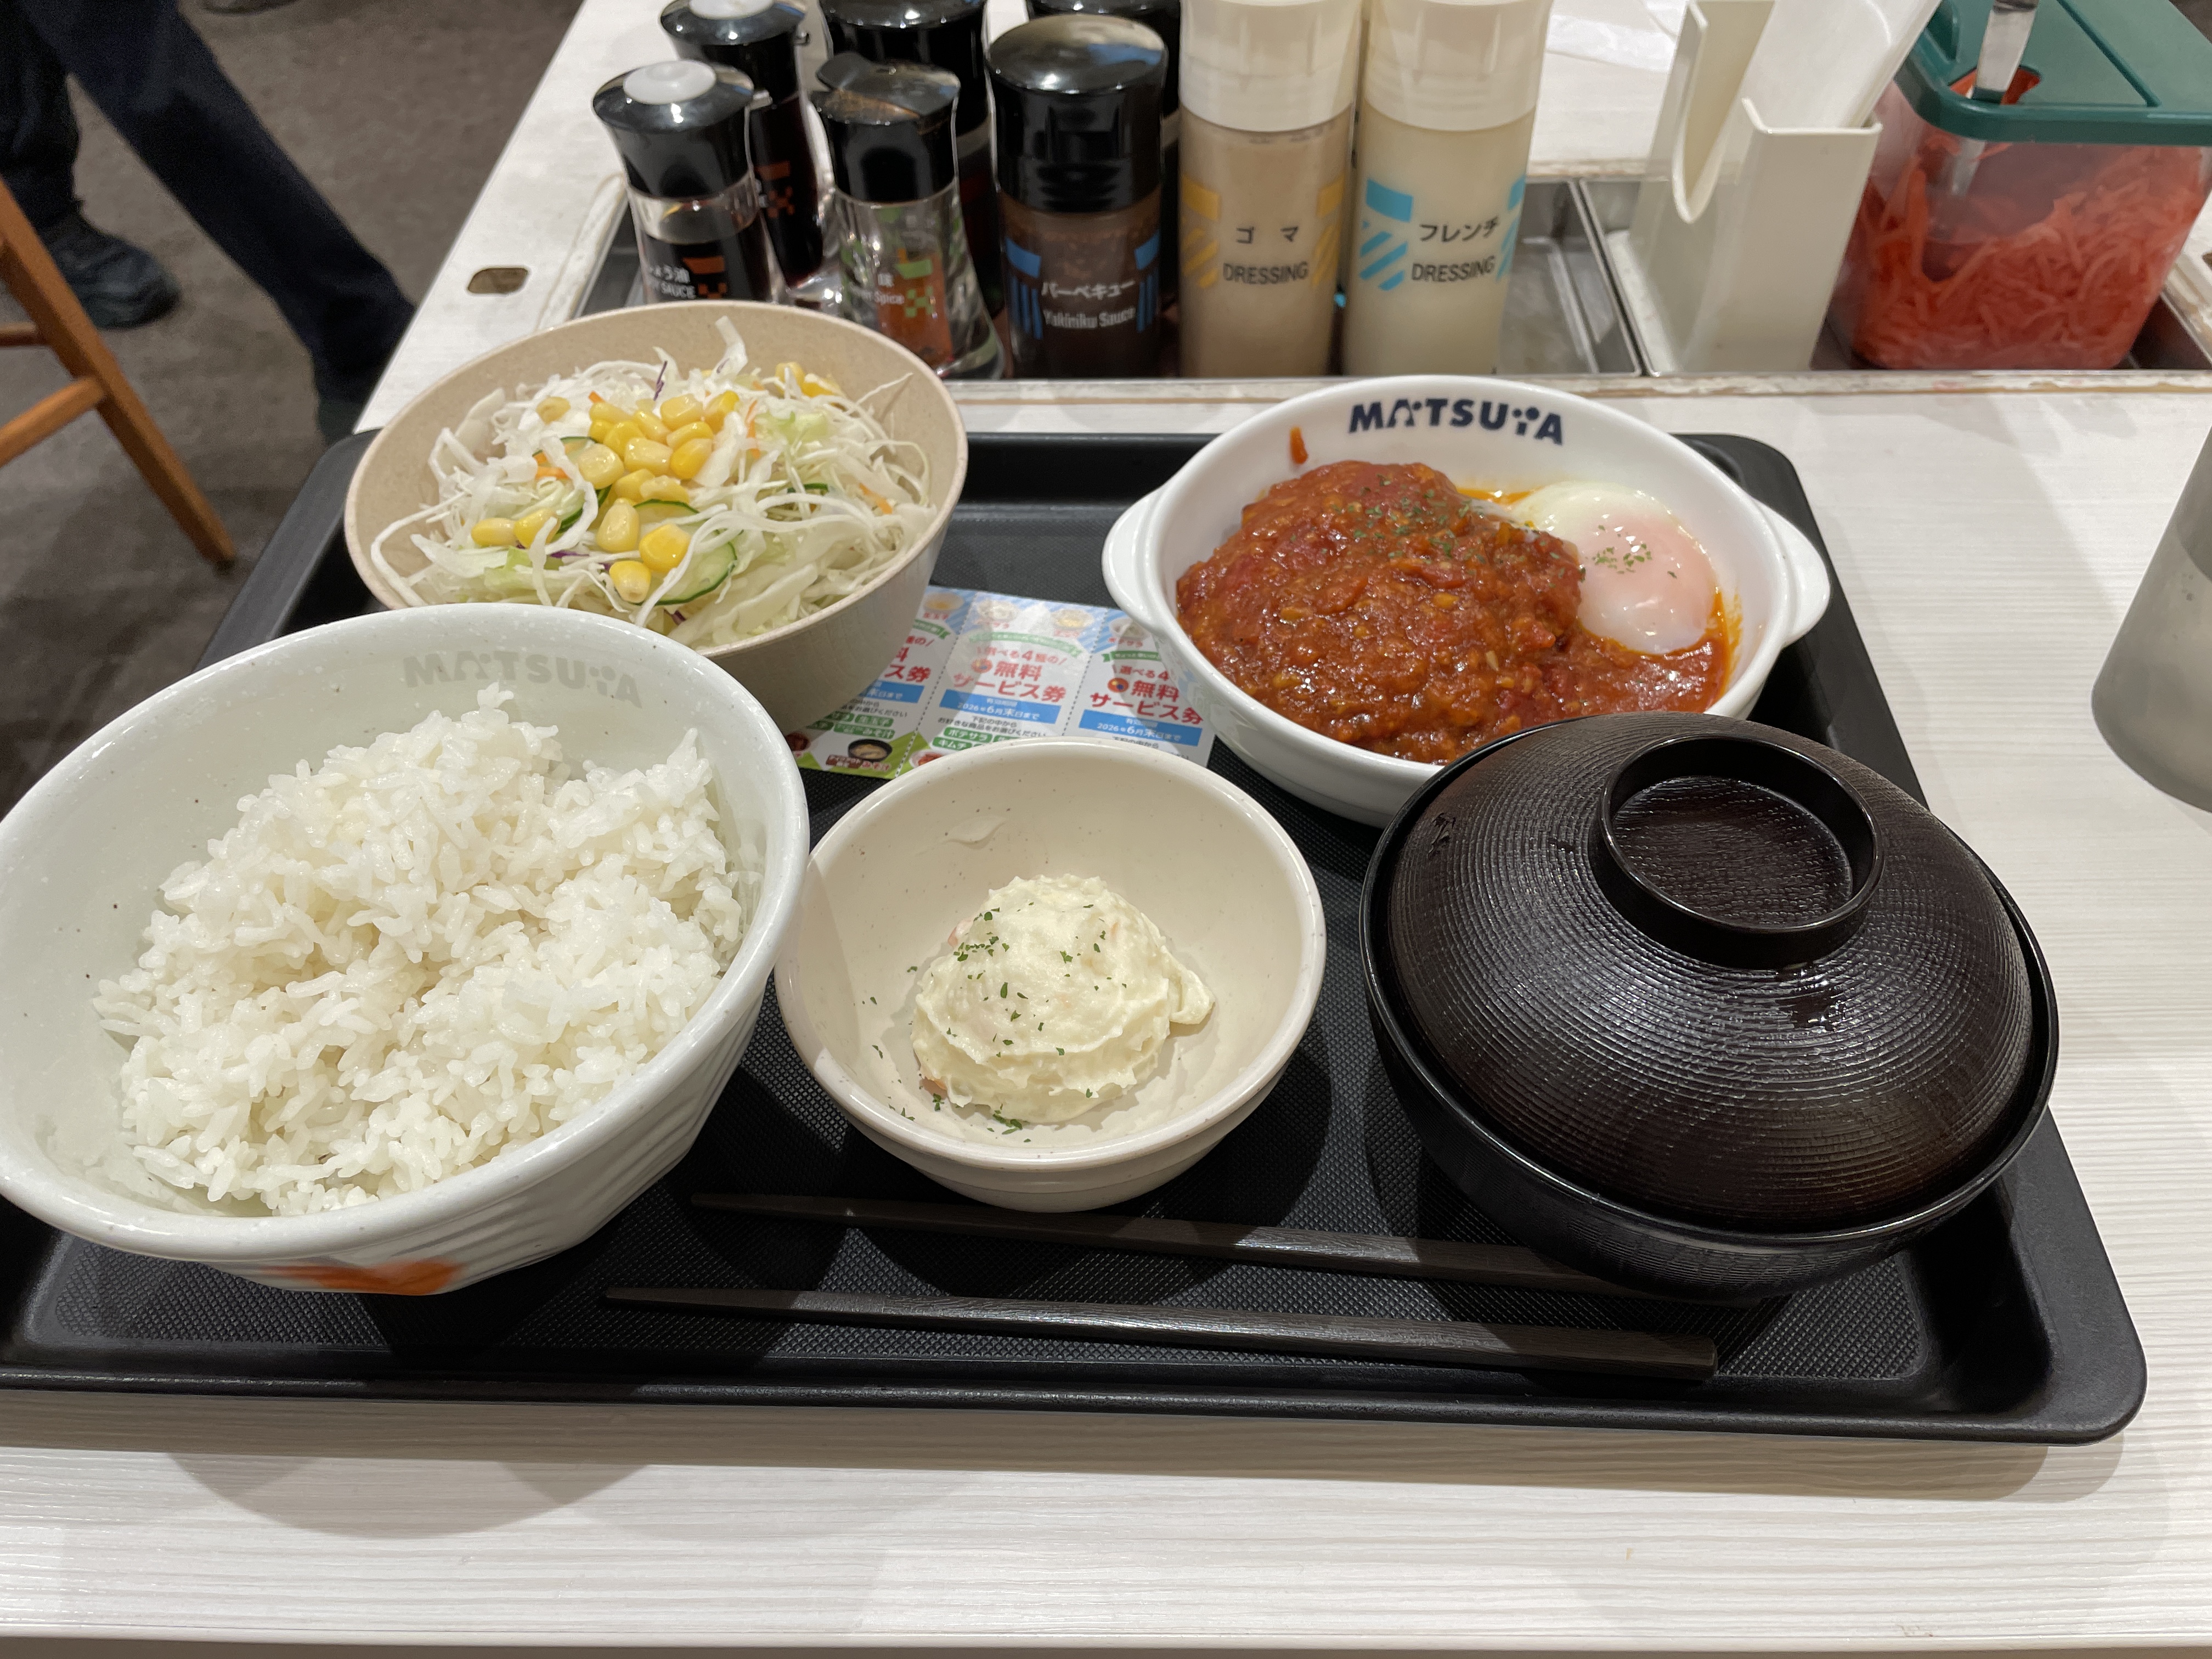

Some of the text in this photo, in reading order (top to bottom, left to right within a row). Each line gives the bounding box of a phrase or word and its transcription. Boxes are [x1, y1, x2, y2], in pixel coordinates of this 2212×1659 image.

[1419, 216, 1499, 242] フレンチ
[1223, 261, 1309, 285] DRESSING
[1412, 255, 1497, 283] DRESSING
[1041, 280, 1136, 300] バーベキュー
[1098, 307, 1136, 328] Sauce
[1349, 398, 1564, 445] MATSUYA
[403, 650, 643, 709] MATSUYA
[994, 661, 1042, 681] 無料
[953, 673, 1066, 703] サービス券
[1132, 680, 1180, 703] 無料
